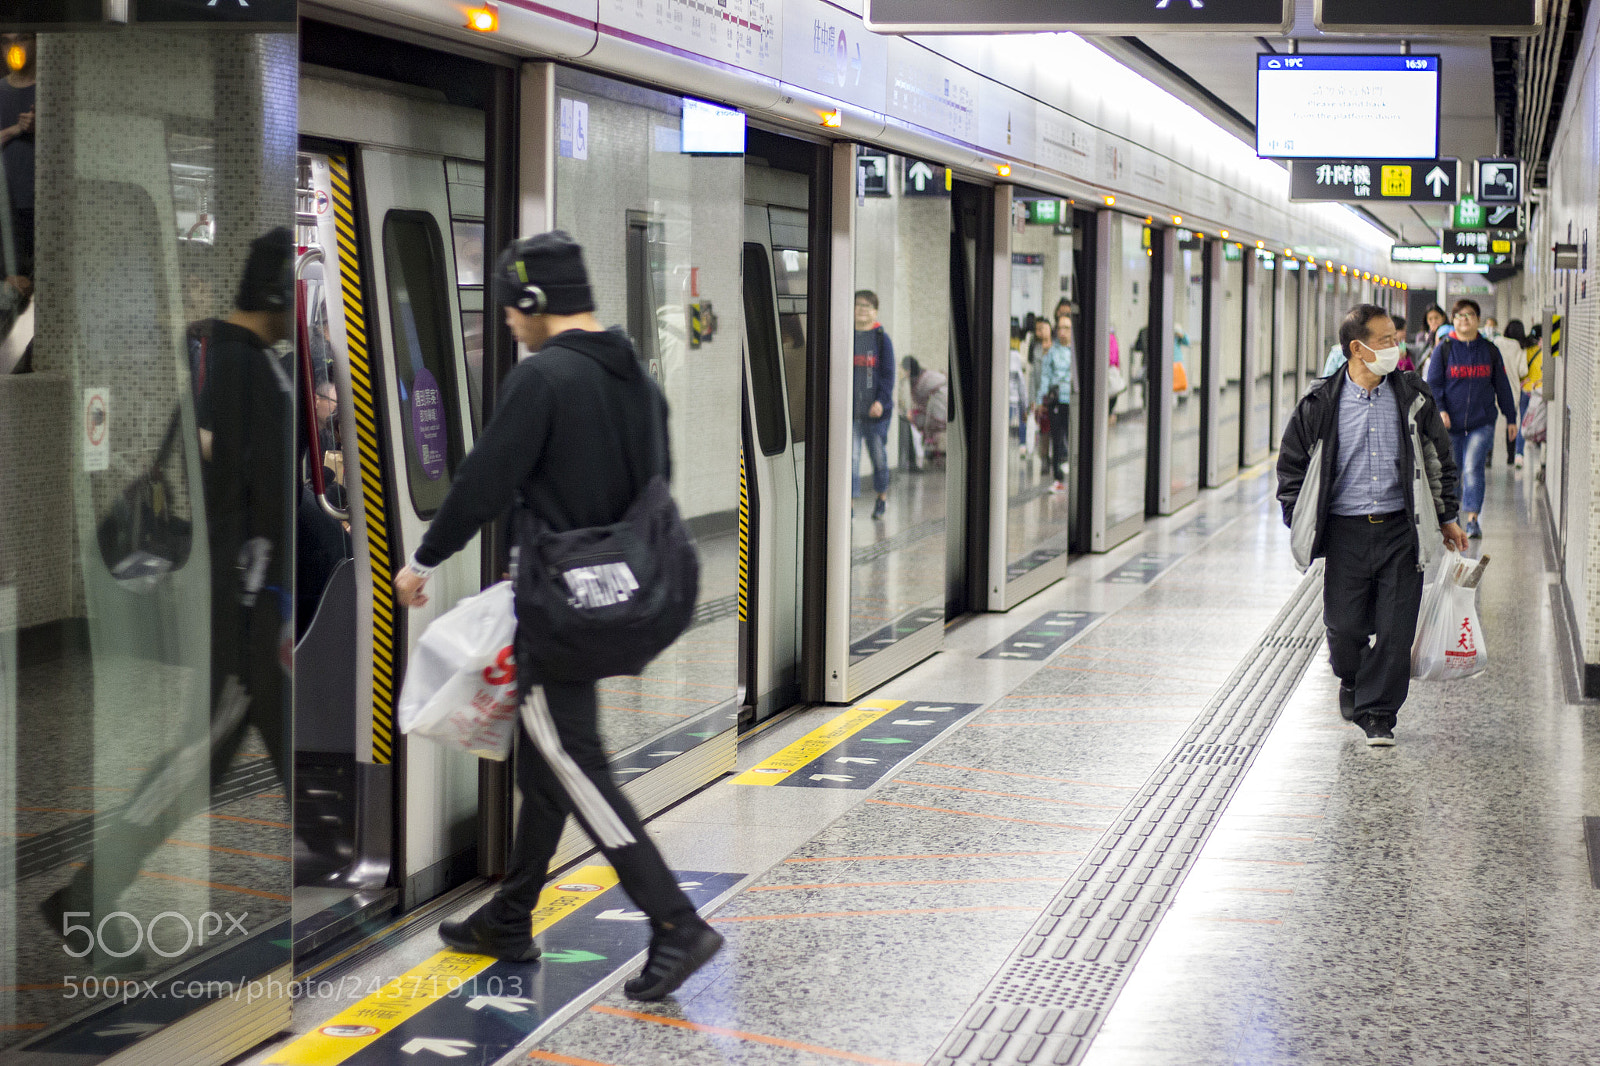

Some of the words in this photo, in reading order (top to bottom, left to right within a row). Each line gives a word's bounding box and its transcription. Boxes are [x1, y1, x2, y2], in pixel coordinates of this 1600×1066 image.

[1405, 60, 1428, 70] 16:59
[1315, 164, 1371, 185] 升降機
[1354, 185, 1371, 196] Lift
